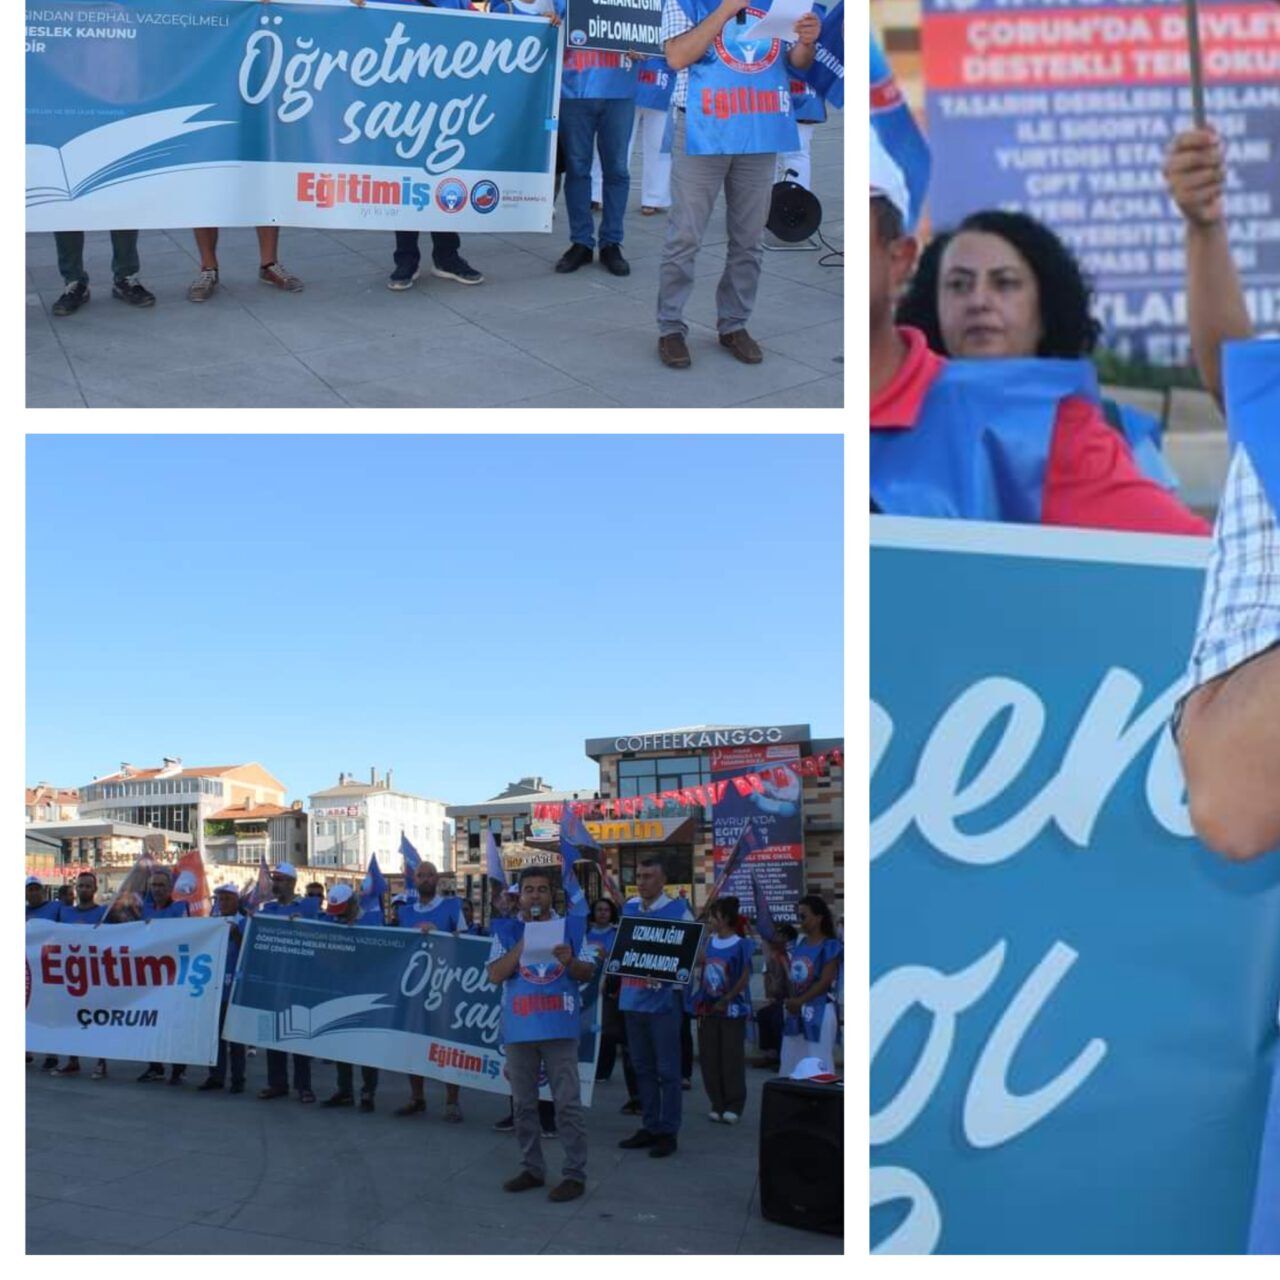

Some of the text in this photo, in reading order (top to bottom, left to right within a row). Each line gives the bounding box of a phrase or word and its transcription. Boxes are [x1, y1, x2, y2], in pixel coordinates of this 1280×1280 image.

[78, 13, 132, 23] DERHAL
[137, 13, 229, 28] VAZGEÇİLMELİ
[589, 18, 662, 45] DİPLOMAMDI
[76, 28, 137, 39] KANUNU
[239, 15, 549, 123] Öğretmene
[339, 93, 496, 174] saygı
[77, 1008, 158, 1029] ÇORUM
